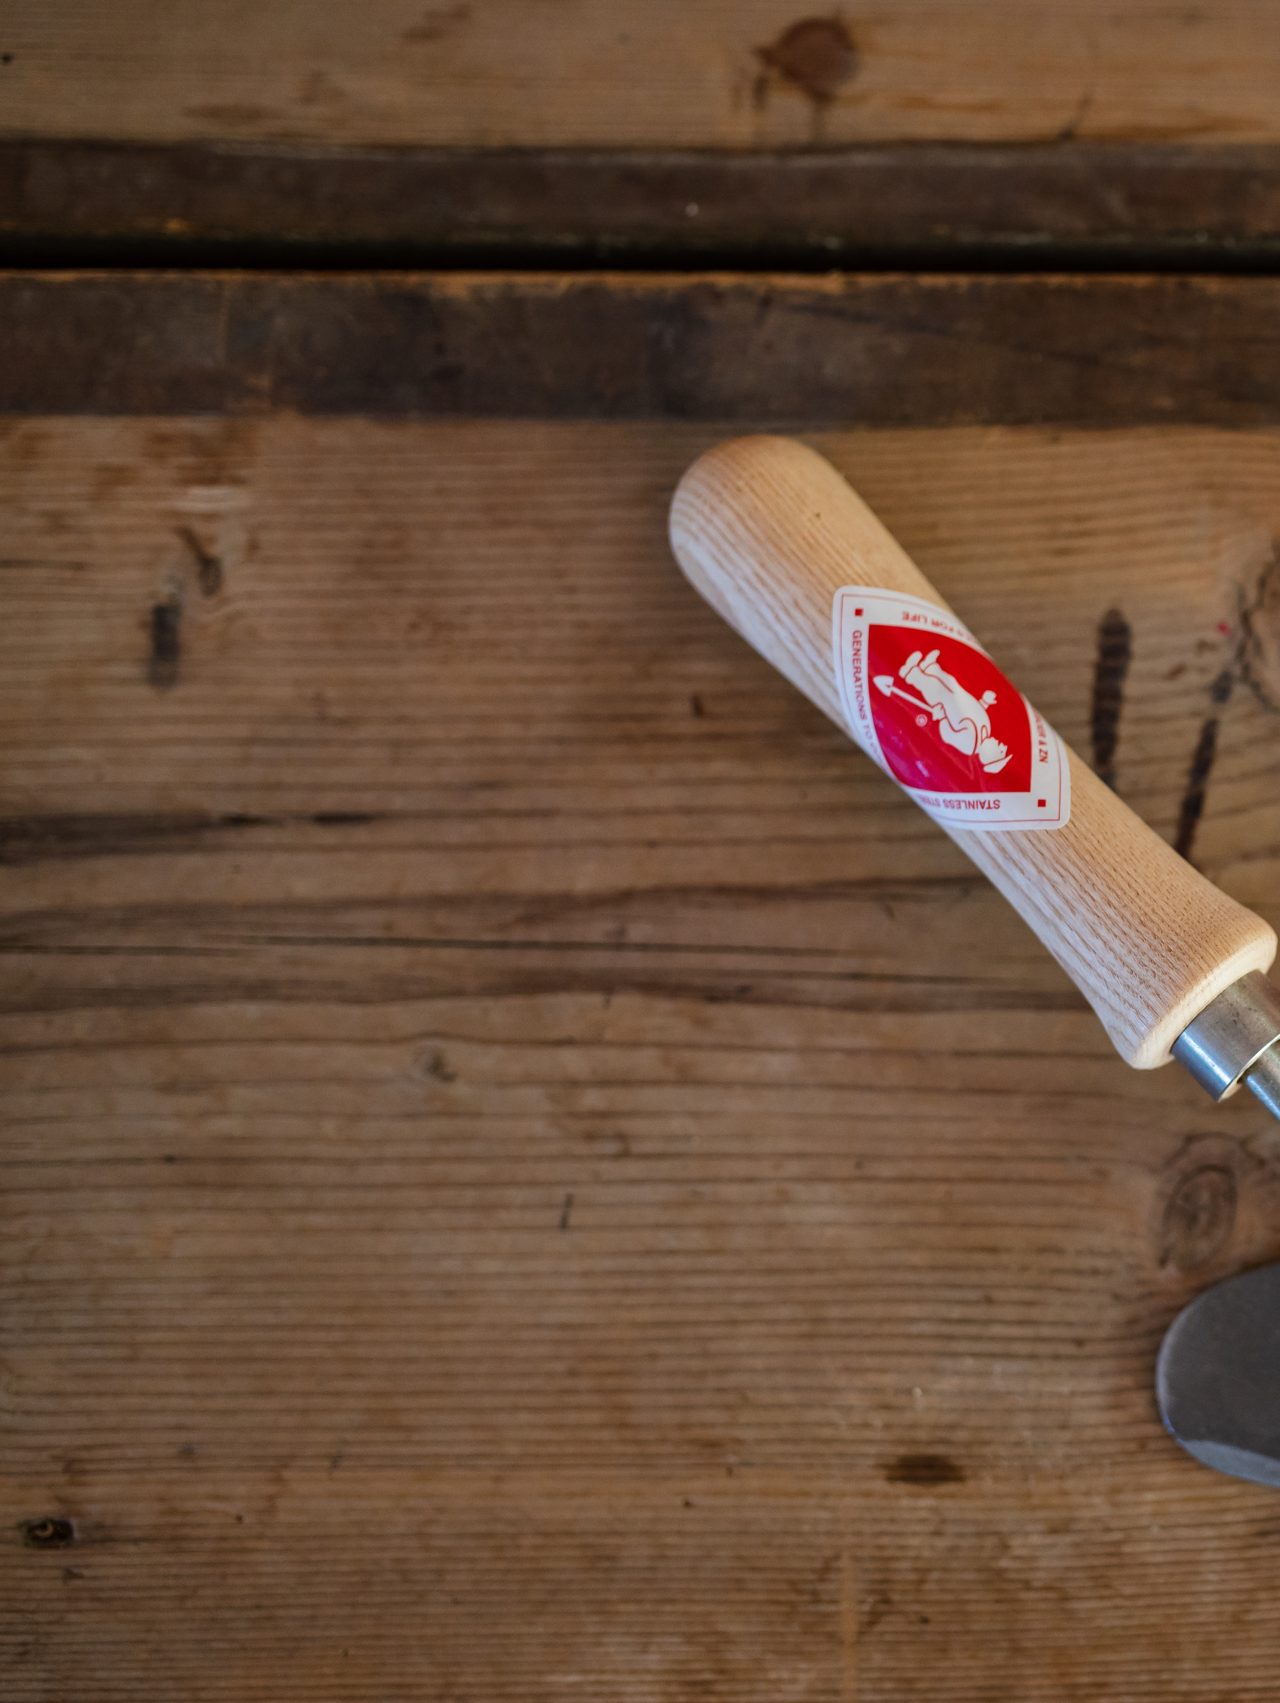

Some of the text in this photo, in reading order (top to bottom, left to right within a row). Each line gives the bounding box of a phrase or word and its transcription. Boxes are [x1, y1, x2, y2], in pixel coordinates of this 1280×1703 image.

[902, 611, 928, 625] LIFE
[852, 630, 868, 721] GENERATIONS
[1039, 747, 1048, 763] ZN
[942, 798, 1001, 810] STAINLESS
